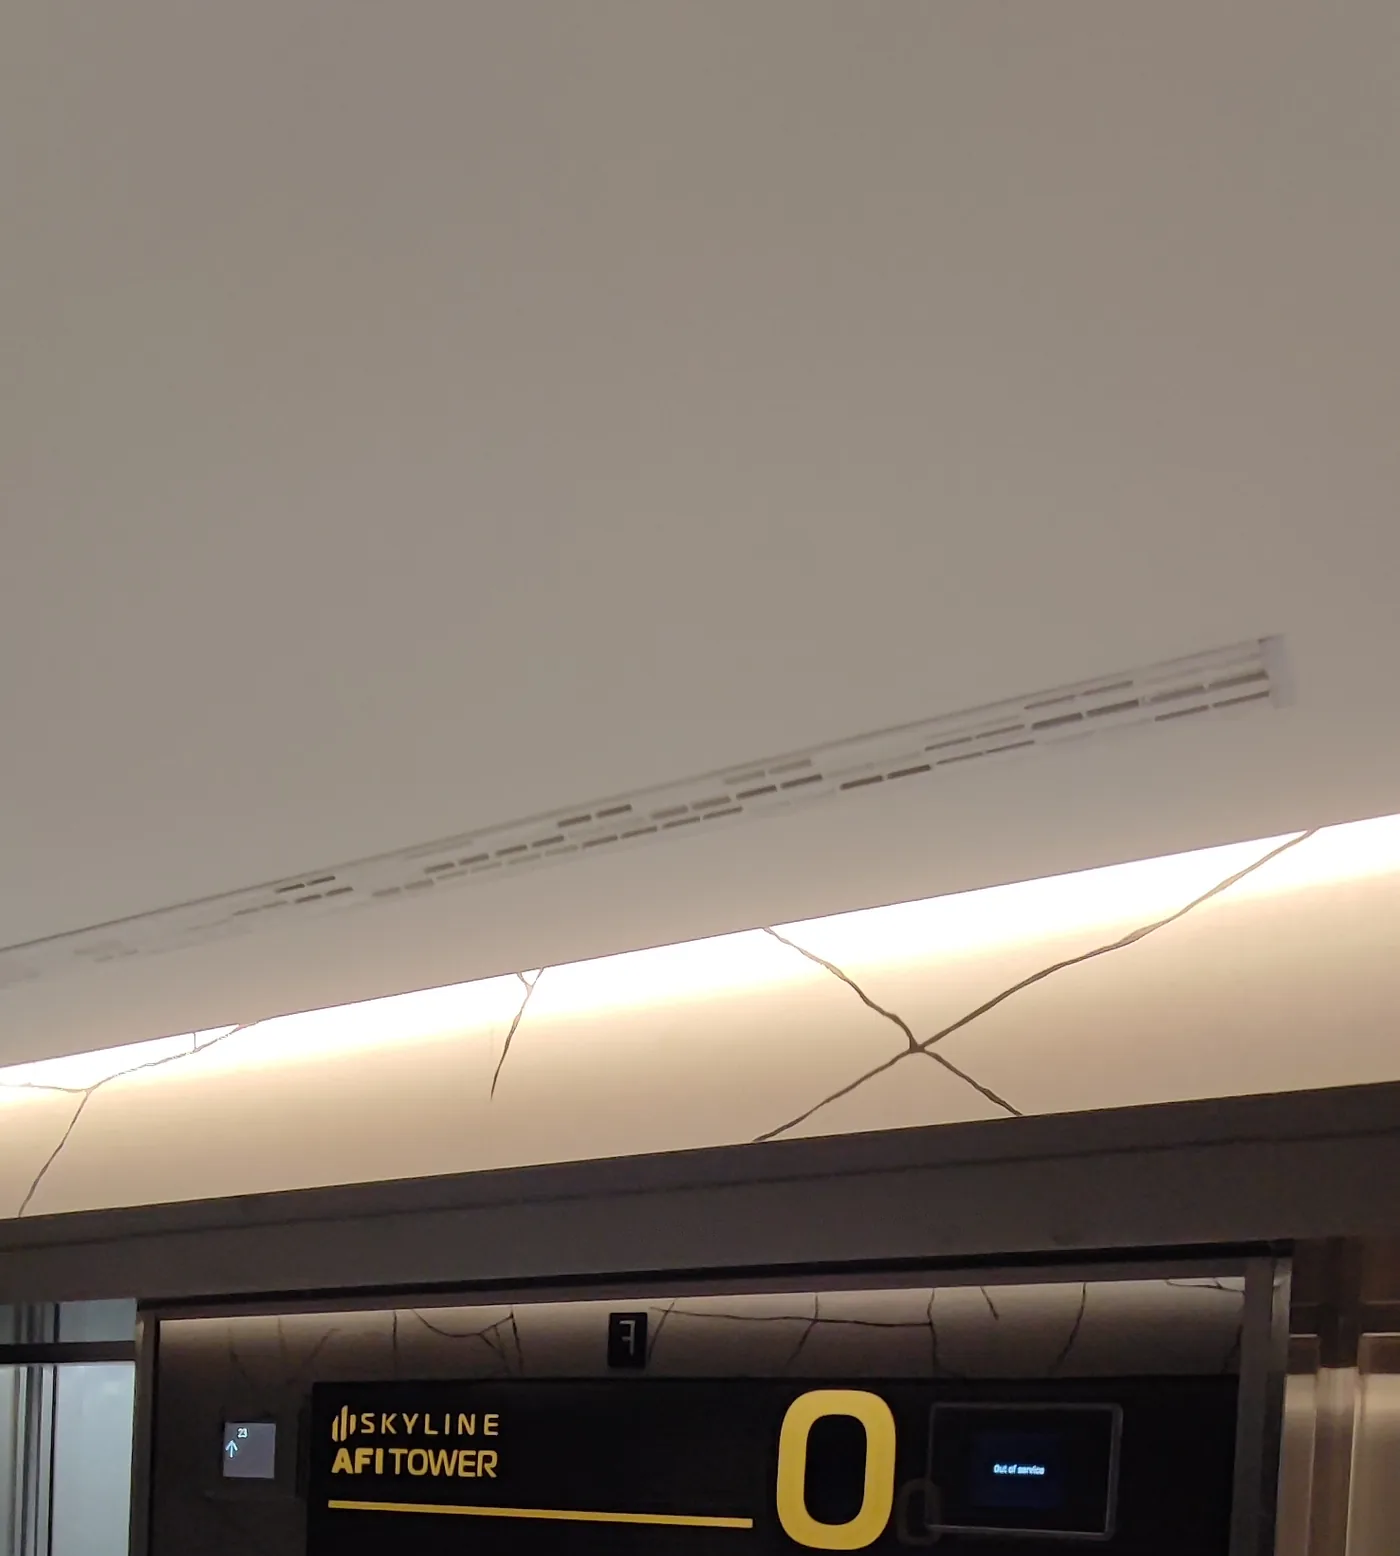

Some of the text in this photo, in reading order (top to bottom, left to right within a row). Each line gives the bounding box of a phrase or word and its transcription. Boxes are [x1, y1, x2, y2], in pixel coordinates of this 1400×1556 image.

[360, 1412, 499, 1436] SKYLINE
[993, 1463, 1008, 1475] Out
[1008, 1463, 1017, 1475] of
